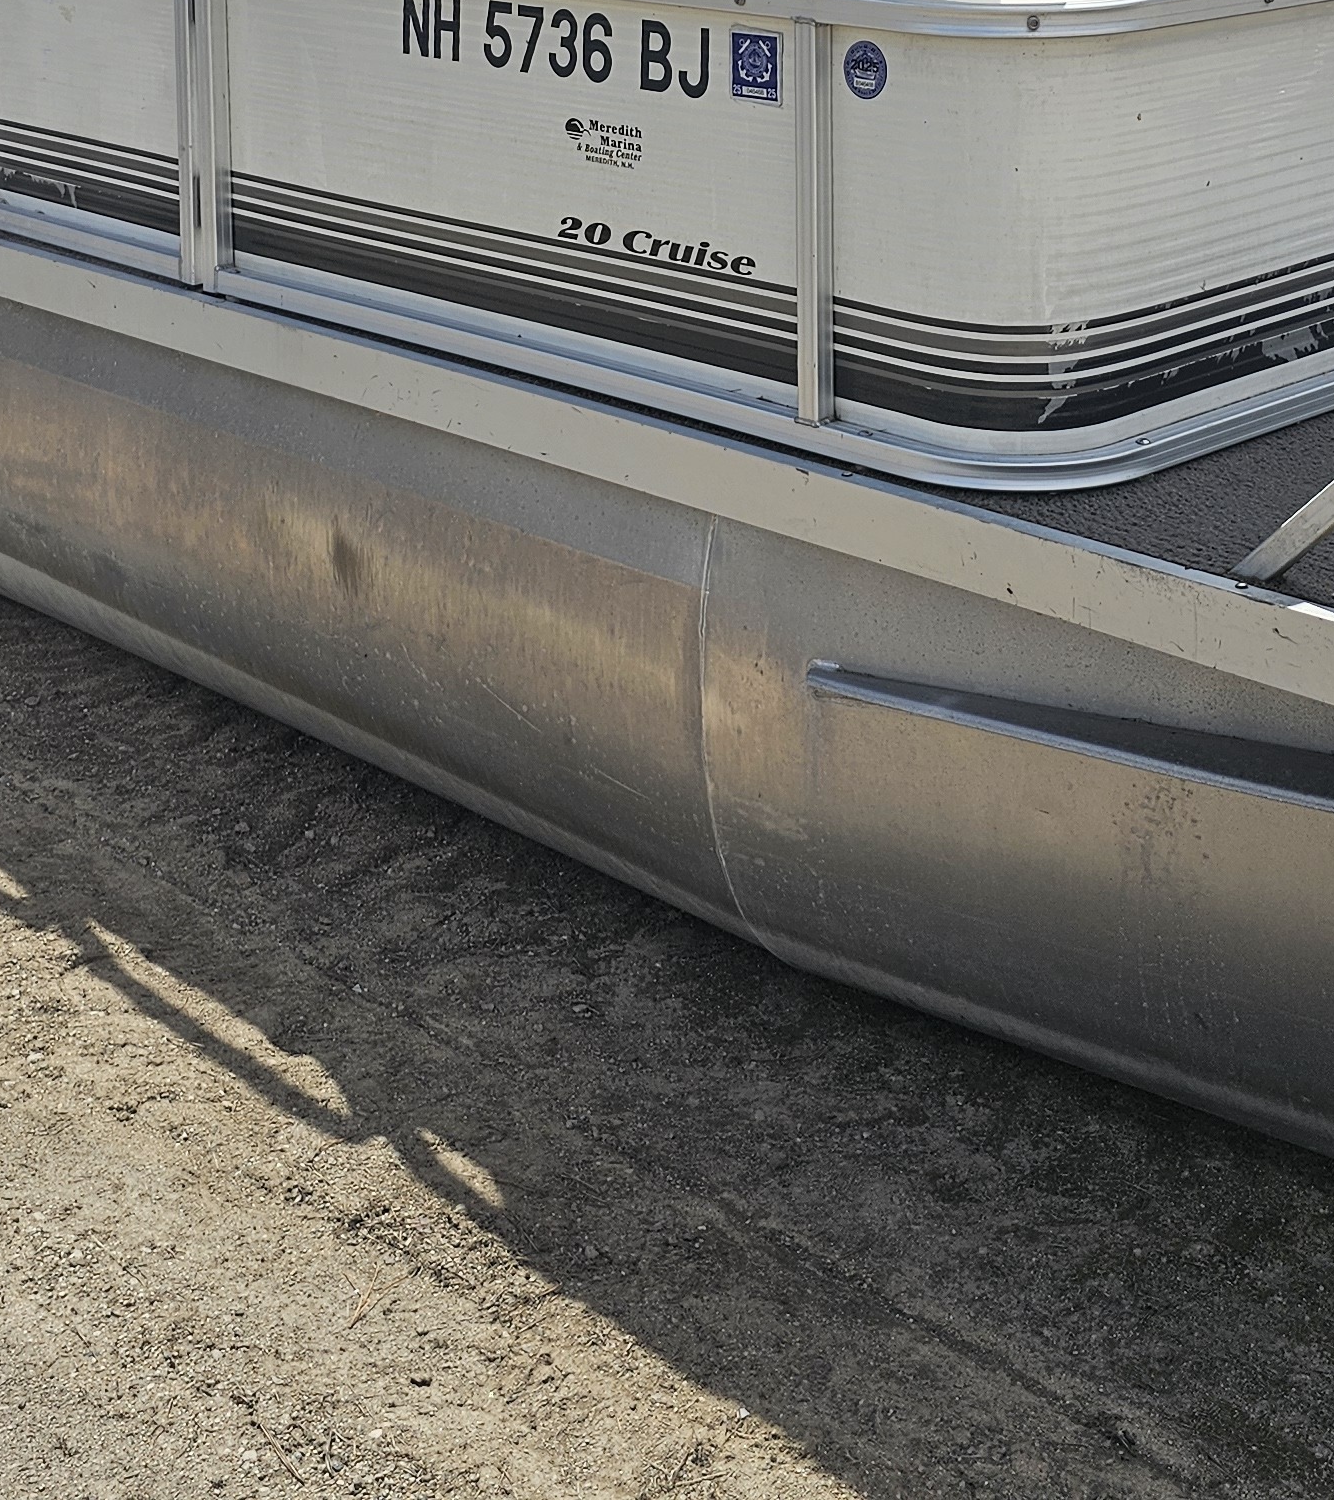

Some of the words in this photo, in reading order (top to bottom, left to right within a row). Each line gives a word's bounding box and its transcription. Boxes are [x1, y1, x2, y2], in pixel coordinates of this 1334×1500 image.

[483, 0, 613, 83] 5736
[640, 19, 710, 98] BJ
[850, 58, 880, 74] 2025
[732, 83, 742, 95] 25
[767, 87, 777, 99] 25
[589, 118, 642, 139] Meredith
[584, 143, 615, 159] Boating
[616, 149, 643, 162] Center
[600, 134, 642, 153] Marina
[557, 216, 612, 246] 20
[622, 230, 757, 276] Cruise
